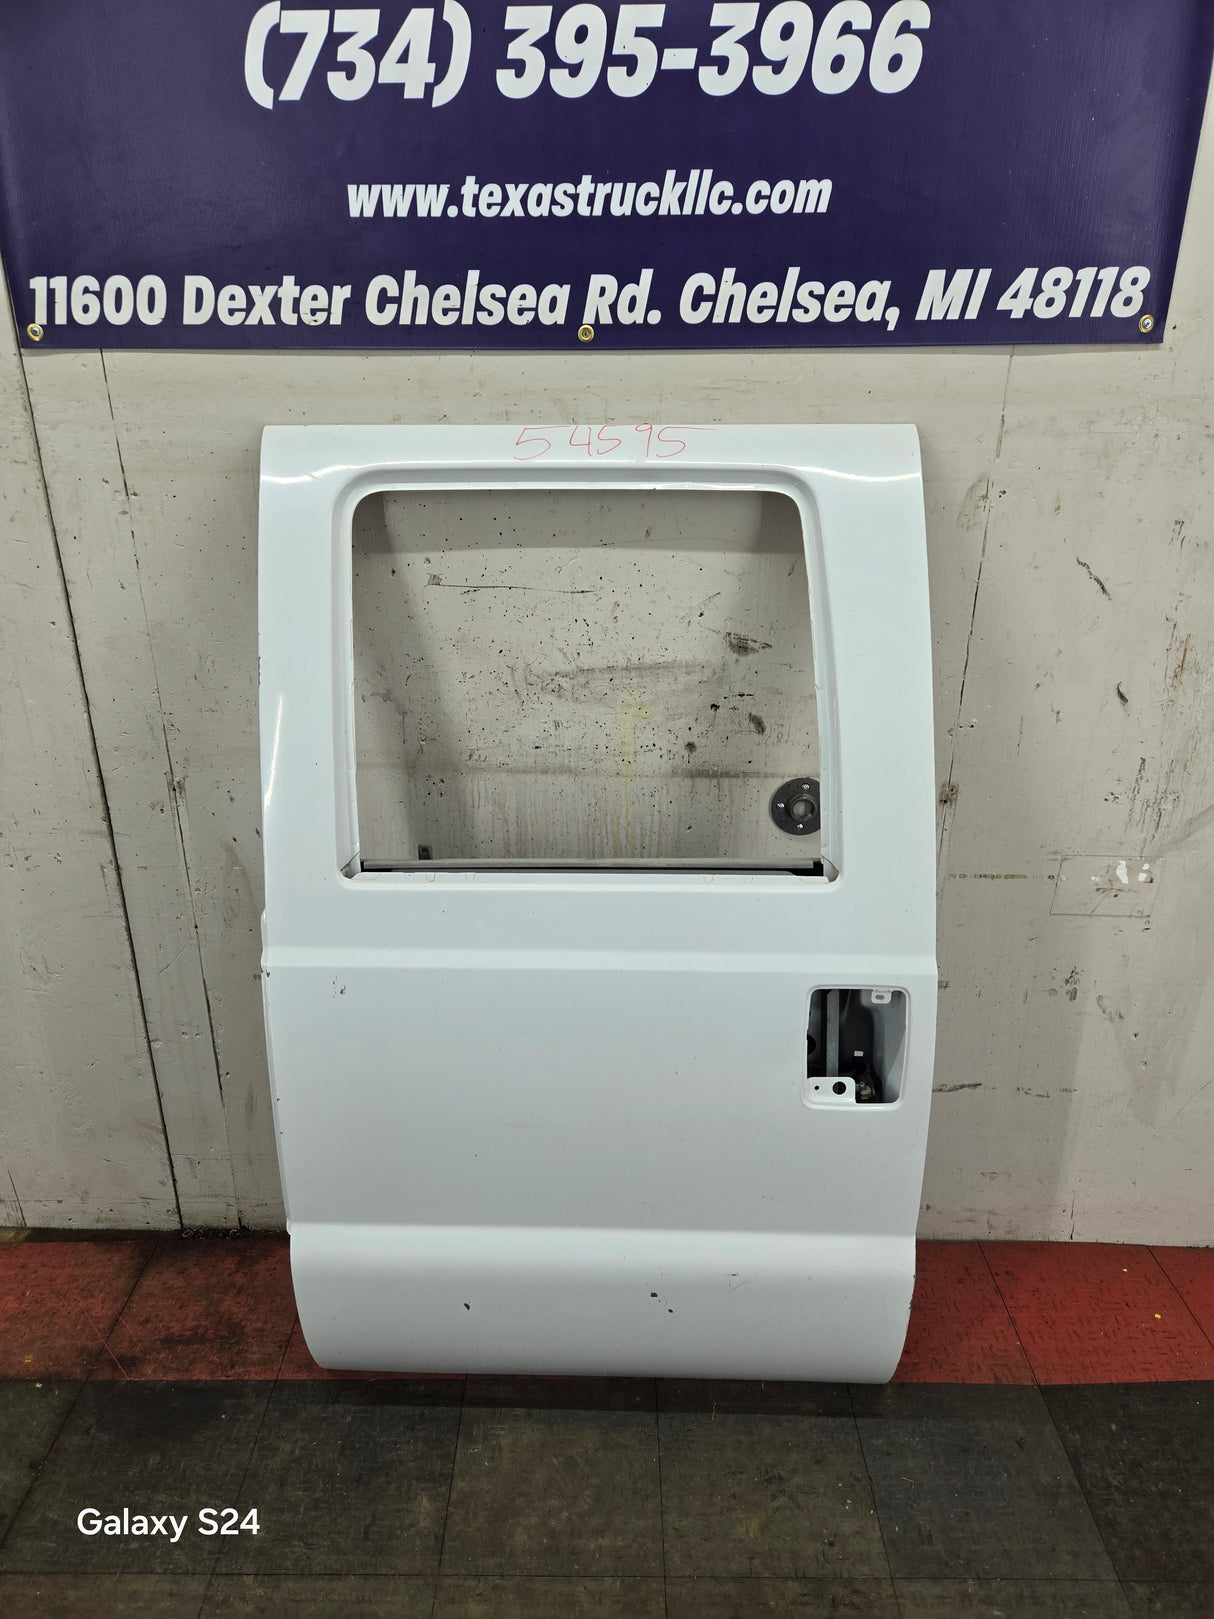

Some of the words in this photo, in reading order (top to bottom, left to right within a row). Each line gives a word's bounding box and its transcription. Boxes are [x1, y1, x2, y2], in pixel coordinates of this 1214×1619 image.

[245, 0, 471, 109] (734)
[496, 0, 930, 98] 395-3966
[348, 169, 832, 218] www.texastruckllc.com
[29, 275, 166, 325] 11600
[183, 276, 351, 325] Dexter
[366, 270, 570, 325] Chelsea
[583, 269, 661, 324] Rd.
[680, 267, 899, 330] Chelsea,
[915, 269, 992, 320] MI
[997, 266, 1150, 318] 48118
